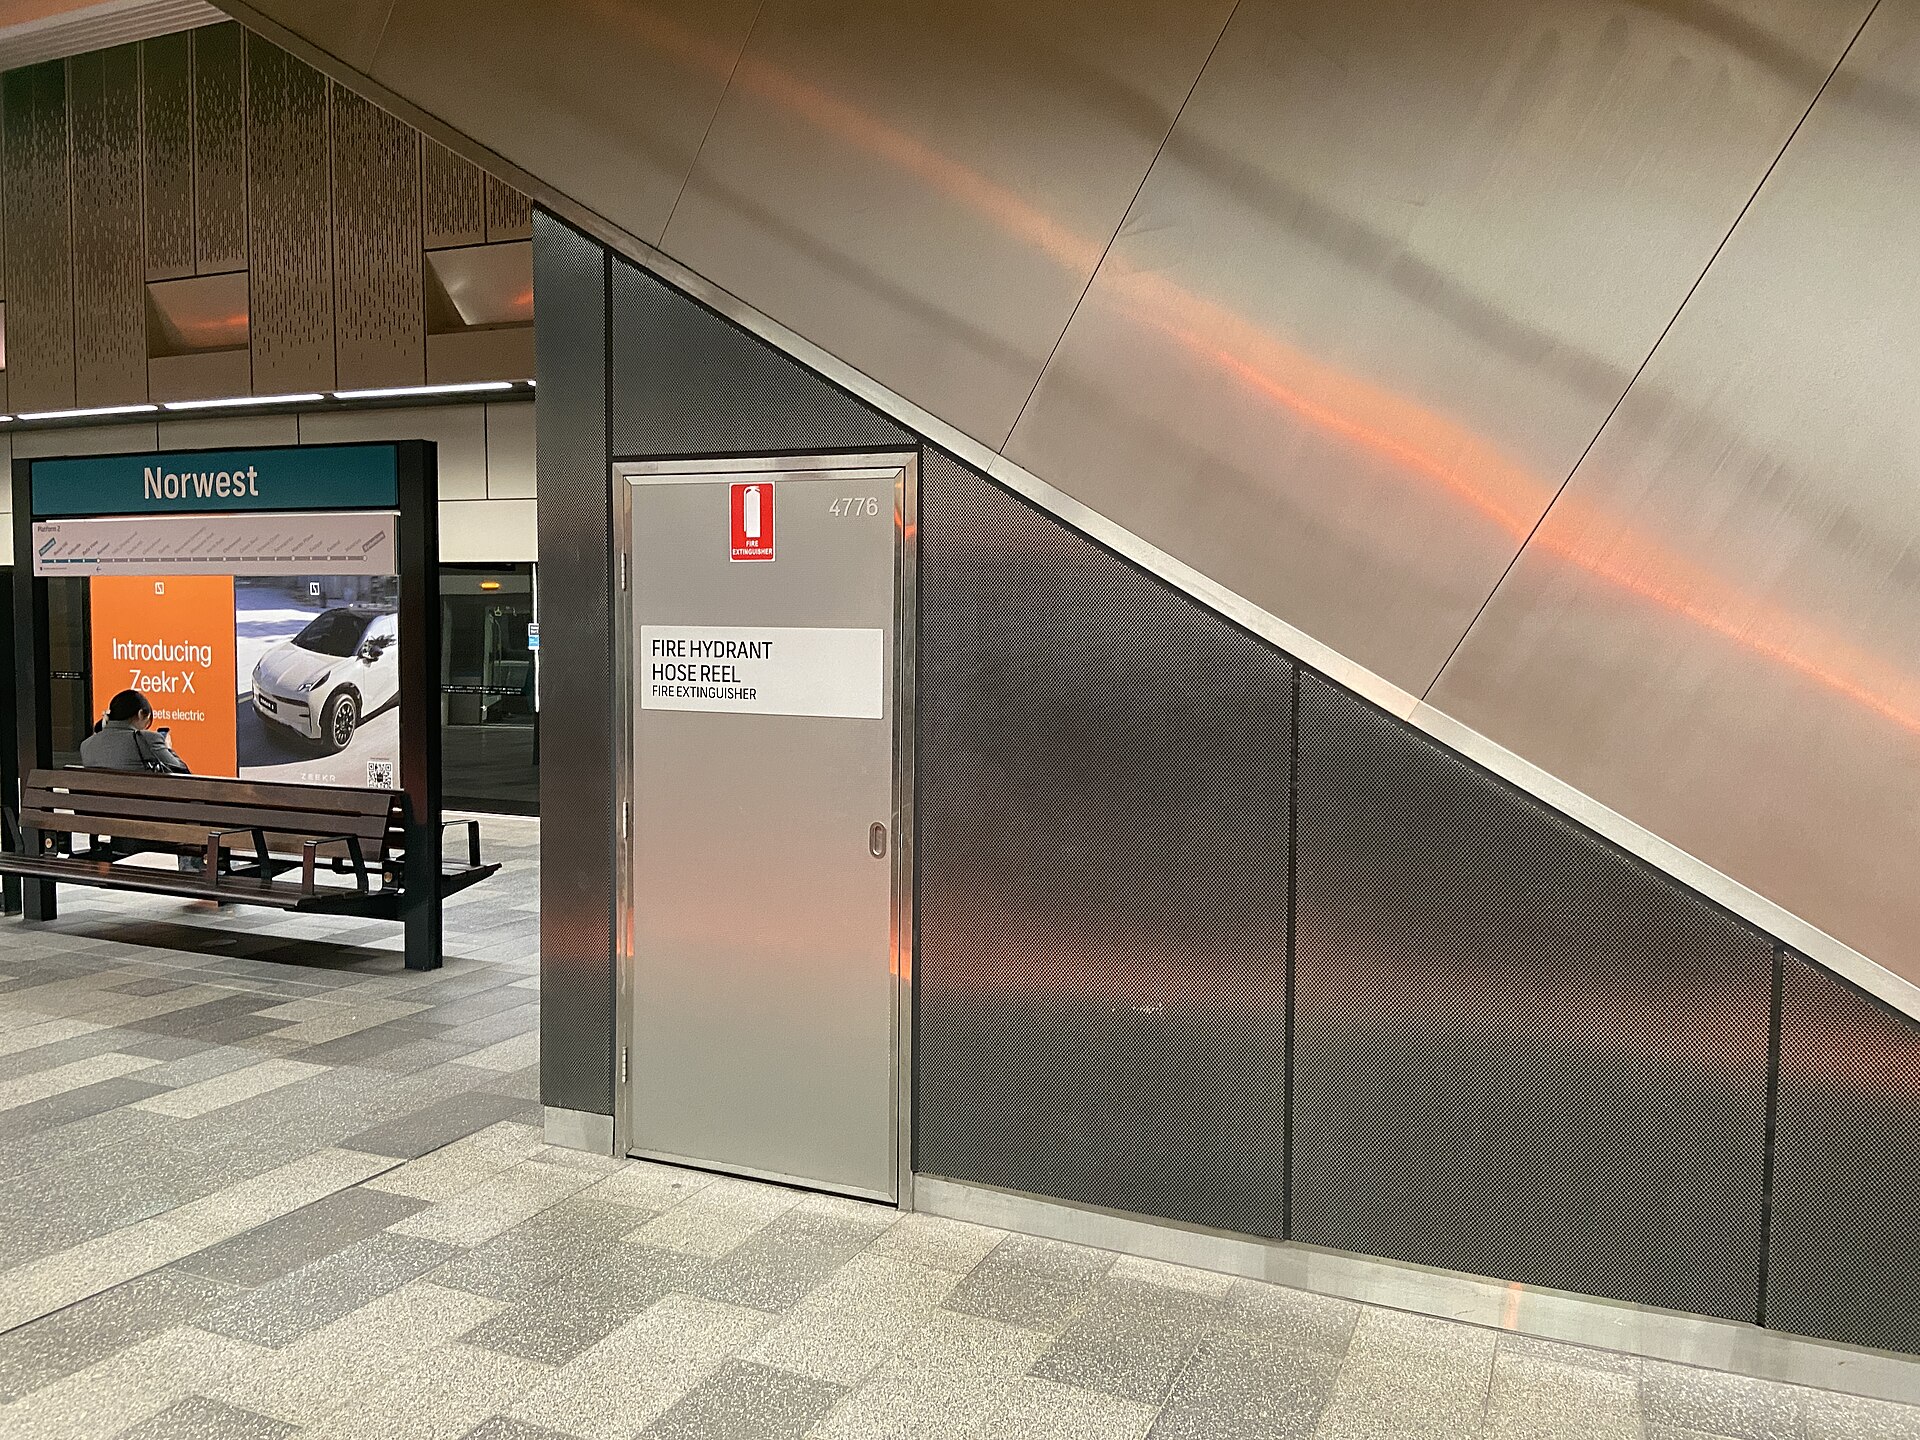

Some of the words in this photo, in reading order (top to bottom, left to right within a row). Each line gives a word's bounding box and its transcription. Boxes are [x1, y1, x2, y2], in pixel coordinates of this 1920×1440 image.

[144, 465, 259, 499] Norwest
[828, 496, 879, 517] 4776
[732, 548, 773, 556] EXTINGUISHER
[112, 638, 212, 668] Introducing
[652, 639, 686, 657] FIRE
[690, 640, 773, 660] HYDRANT
[129, 669, 179, 693] Zeekr
[181, 671, 195, 694] X
[652, 663, 697, 682] HOSE
[700, 664, 741, 683] REEL
[652, 684, 675, 697] FIRE
[676, 685, 757, 700] EXTINGUISHER
[152, 708, 171, 720] eets
[172, 708, 205, 722] electric
[300, 772, 337, 783] ZEEKR
